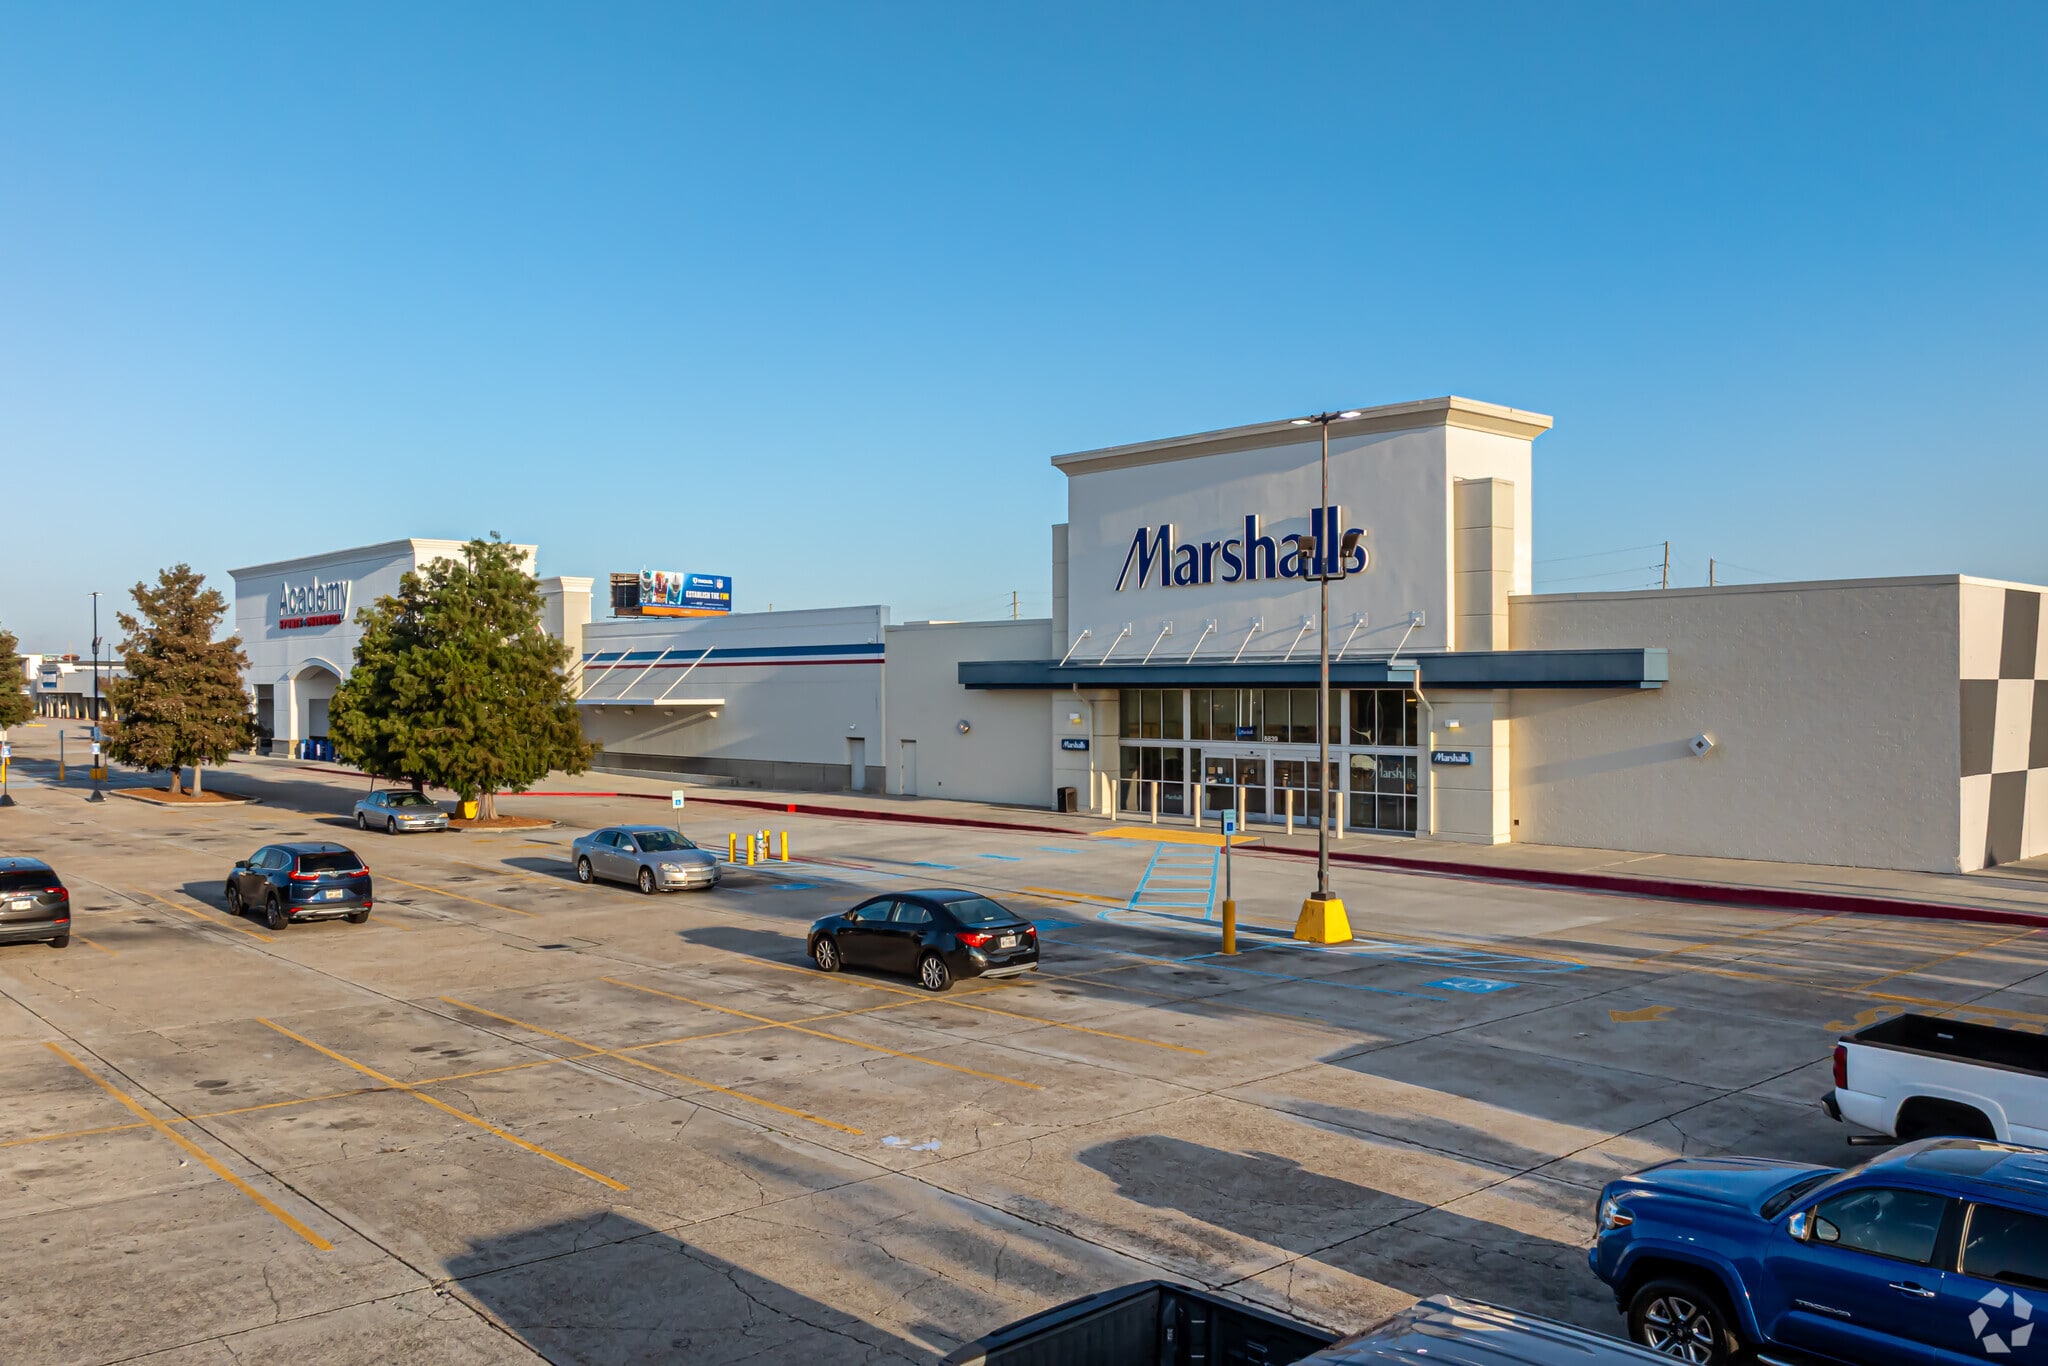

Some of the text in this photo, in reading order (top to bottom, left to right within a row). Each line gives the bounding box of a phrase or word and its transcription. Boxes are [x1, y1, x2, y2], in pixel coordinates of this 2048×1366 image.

[1114, 505, 1370, 592] Marshalls
[280, 576, 352, 621] Academy
[1434, 752, 1470, 763] Marshalls
